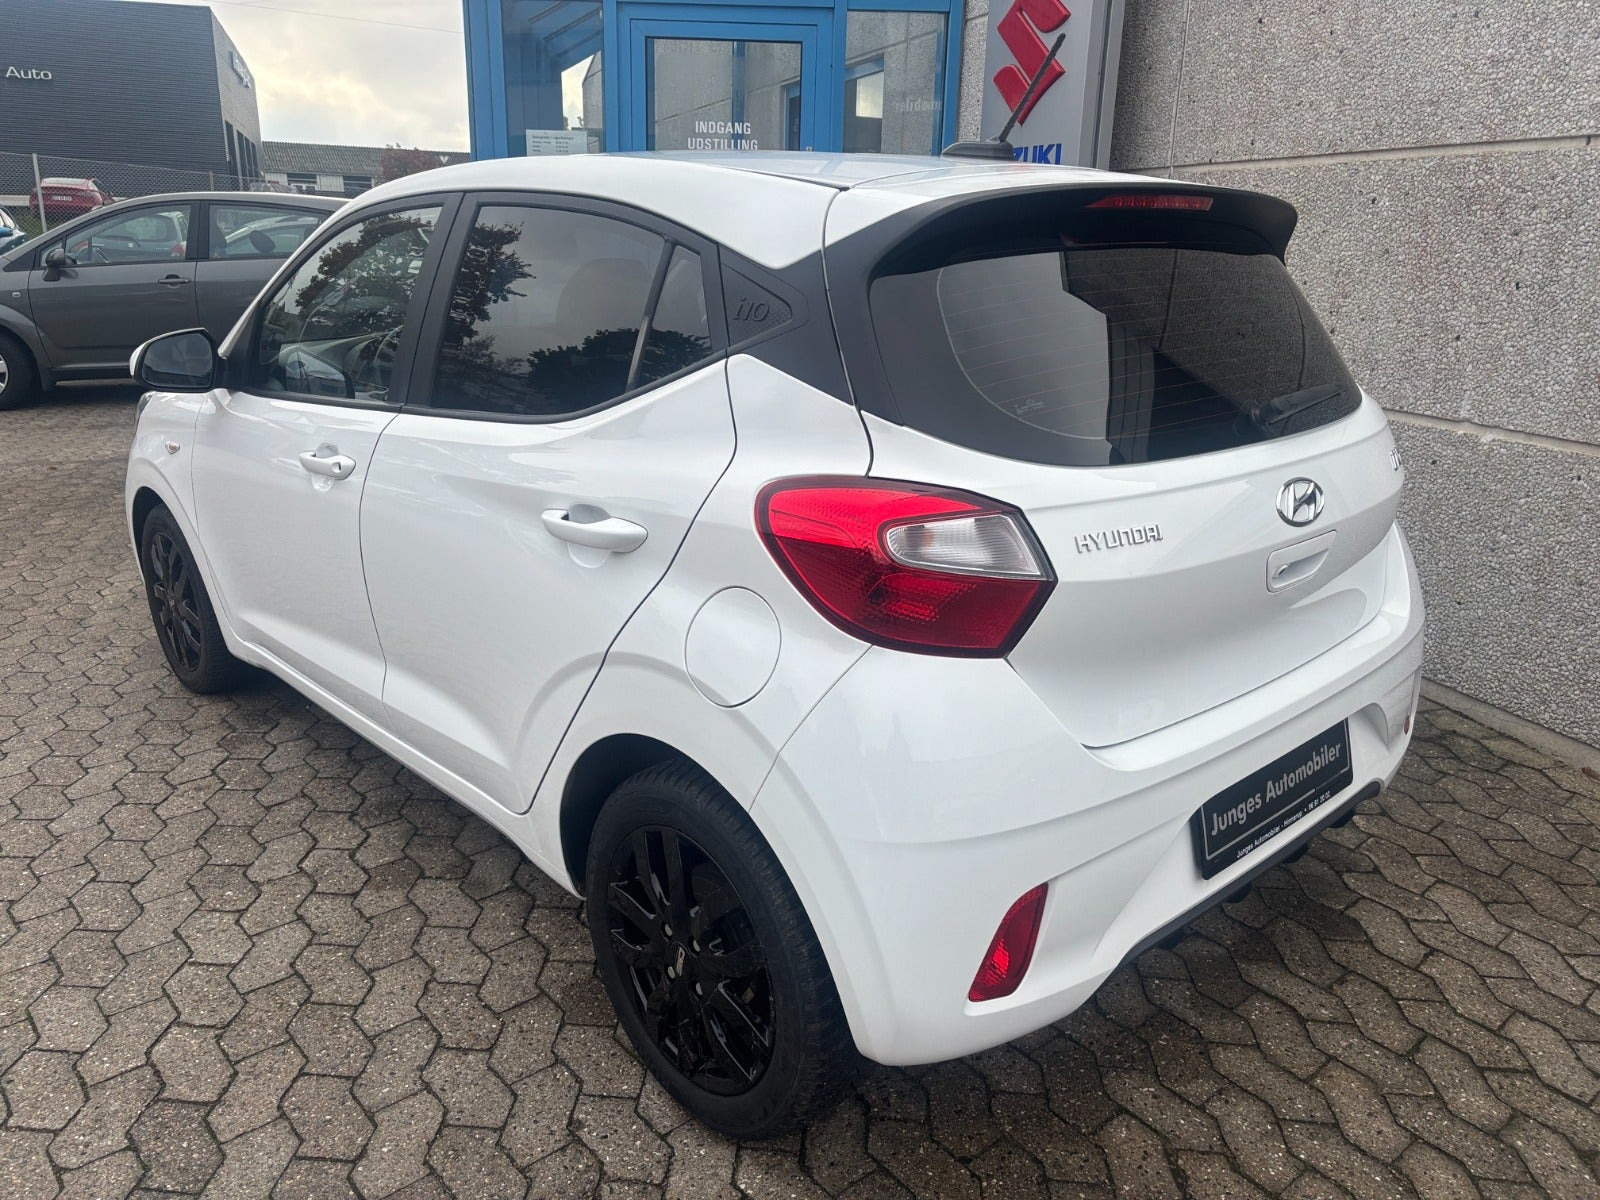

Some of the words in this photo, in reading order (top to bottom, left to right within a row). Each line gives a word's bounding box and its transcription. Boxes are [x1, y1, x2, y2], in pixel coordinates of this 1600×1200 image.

[5, 66, 52, 80] Auto
[695, 121, 751, 135] INDGANG
[687, 137, 758, 150] UDSTILLING
[1012, 143, 1062, 165] ZUKI
[733, 298, 770, 322] i10
[1074, 524, 1164, 554] HYUNDAI
[1211, 792, 1262, 837] Junges
[1265, 743, 1342, 804] Automobiler
[1236, 843, 1254, 858] Junges
[1254, 825, 1281, 847] Automobiler
